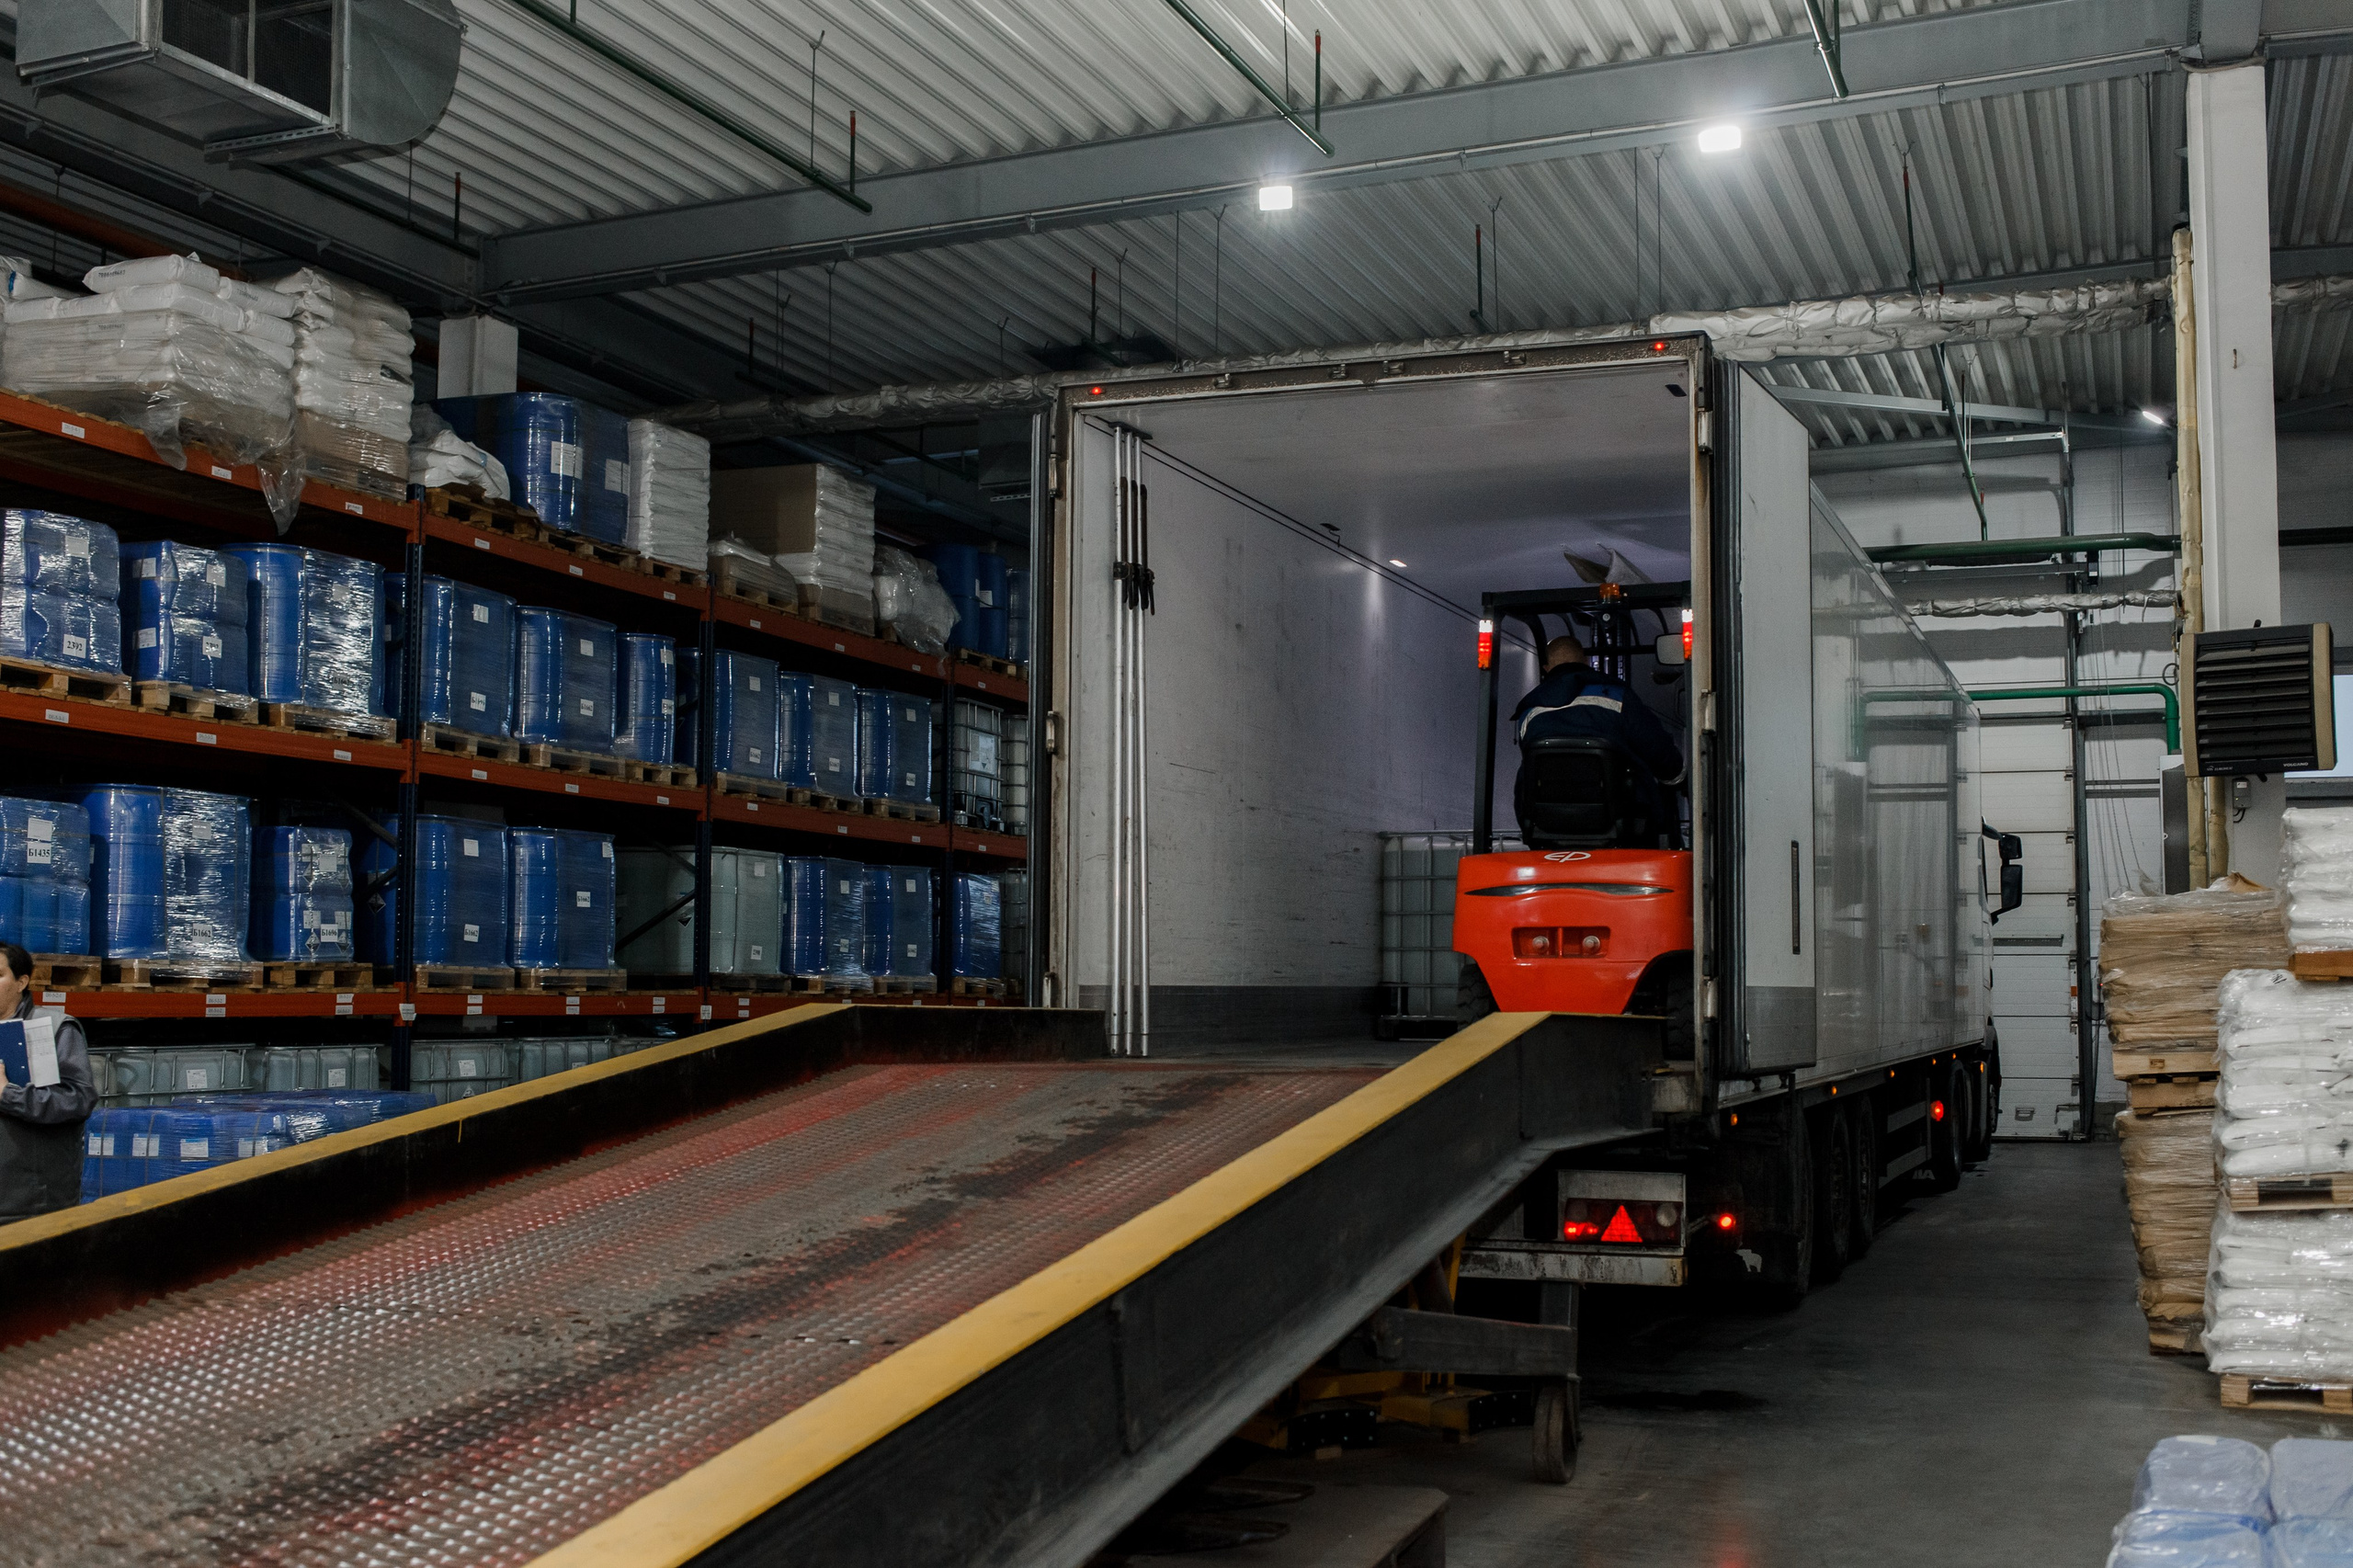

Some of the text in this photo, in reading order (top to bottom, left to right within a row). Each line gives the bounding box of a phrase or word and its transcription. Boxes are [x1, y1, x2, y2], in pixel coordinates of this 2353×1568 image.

[67, 640, 83, 652] 2392
[28, 848, 51, 858] Б1435
[1544, 851, 1592, 863] EP
[193, 929, 211, 938] Б1662
[464, 927, 479, 937] Б1662
